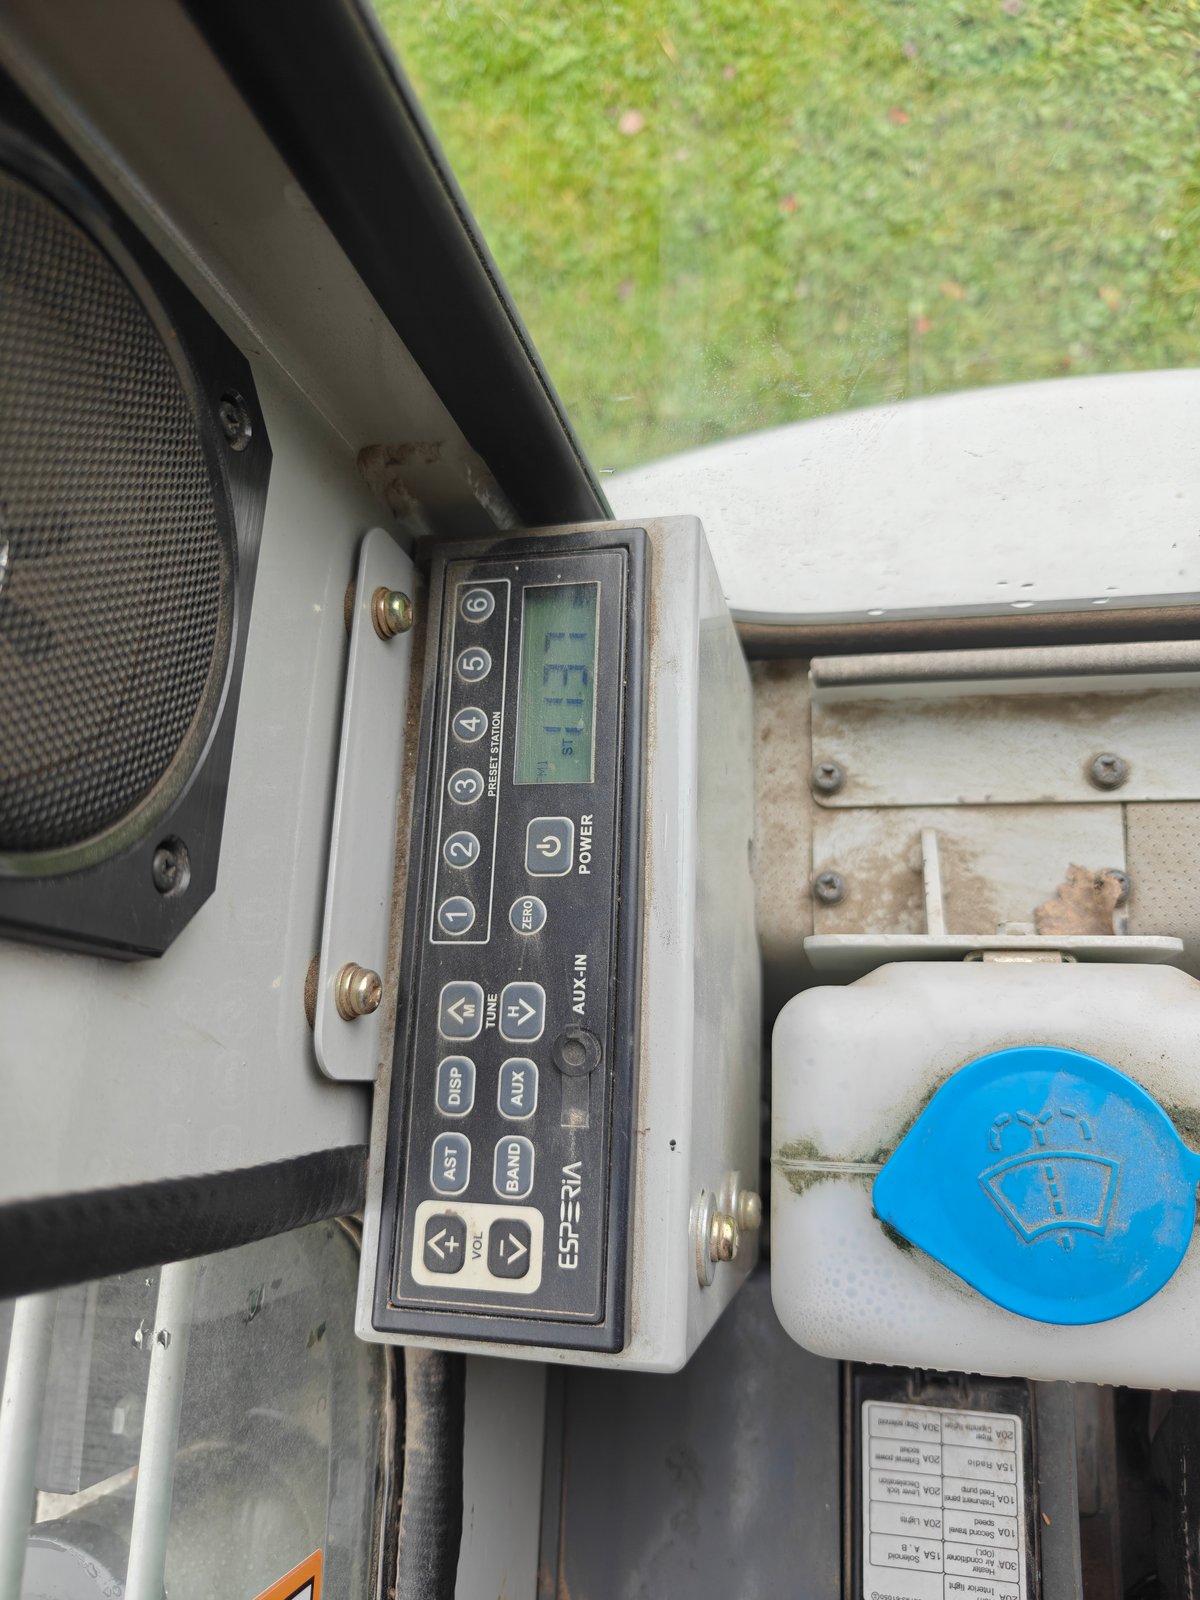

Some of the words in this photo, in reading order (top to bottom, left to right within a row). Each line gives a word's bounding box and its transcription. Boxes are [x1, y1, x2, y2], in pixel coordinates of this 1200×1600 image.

[467, 598, 487, 612] 6
[463, 657, 484, 670] 5
[460, 717, 481, 732] 4
[490, 712, 501, 754] STATION
[561, 738, 574, 755] ST
[488, 756, 499, 797] PRESET
[455, 779, 477, 793] 3
[450, 842, 473, 857] 2
[579, 815, 592, 874] POWER
[446, 910, 468, 923] 1
[522, 901, 533, 929] ZERO
[572, 954, 587, 1014] AUX-IN
[463, 1004, 475, 1017] M
[486, 993, 498, 1029] TUNE
[508, 1006, 519, 1017] H
[448, 1067, 462, 1105] DISP
[511, 1070, 524, 1106] AUX
[444, 1147, 458, 1180] AST
[507, 1143, 520, 1191] BAND
[471, 1232, 483, 1260] VOL
[922, 1423, 940, 1433] 30A
[996, 1431, 1013, 1440] 20A
[923, 1454, 940, 1463] 20A
[968, 1459, 992, 1468] Radio
[996, 1462, 1014, 1471] 15A
[879, 1478, 919, 1488] Deceleration
[887, 1487, 900, 1495] lock
[902, 1488, 920, 1496] Lever
[923, 1486, 940, 1495] 20A
[961, 1486, 978, 1494] pump
[945, 1494, 961, 1503] panel
[963, 1496, 995, 1507] Instrument
[997, 1495, 1014, 1504] 10A
[900, 1516, 920, 1525] Lights
[923, 1519, 941, 1528] 20A
[974, 1519, 994, 1527] speed
[949, 1527, 967, 1535] travel
[969, 1529, 995, 1539] Second
[998, 1528, 1015, 1537] 10A
[888, 1553, 920, 1563] Solenoid
[924, 1551, 941, 1560] 15A
[946, 1554, 983, 1564] conditioner
[985, 1559, 995, 1567] Air
[999, 1561, 1017, 1570] 30A
[949, 1582, 965, 1592] light
[968, 1584, 995, 1595] Interior
